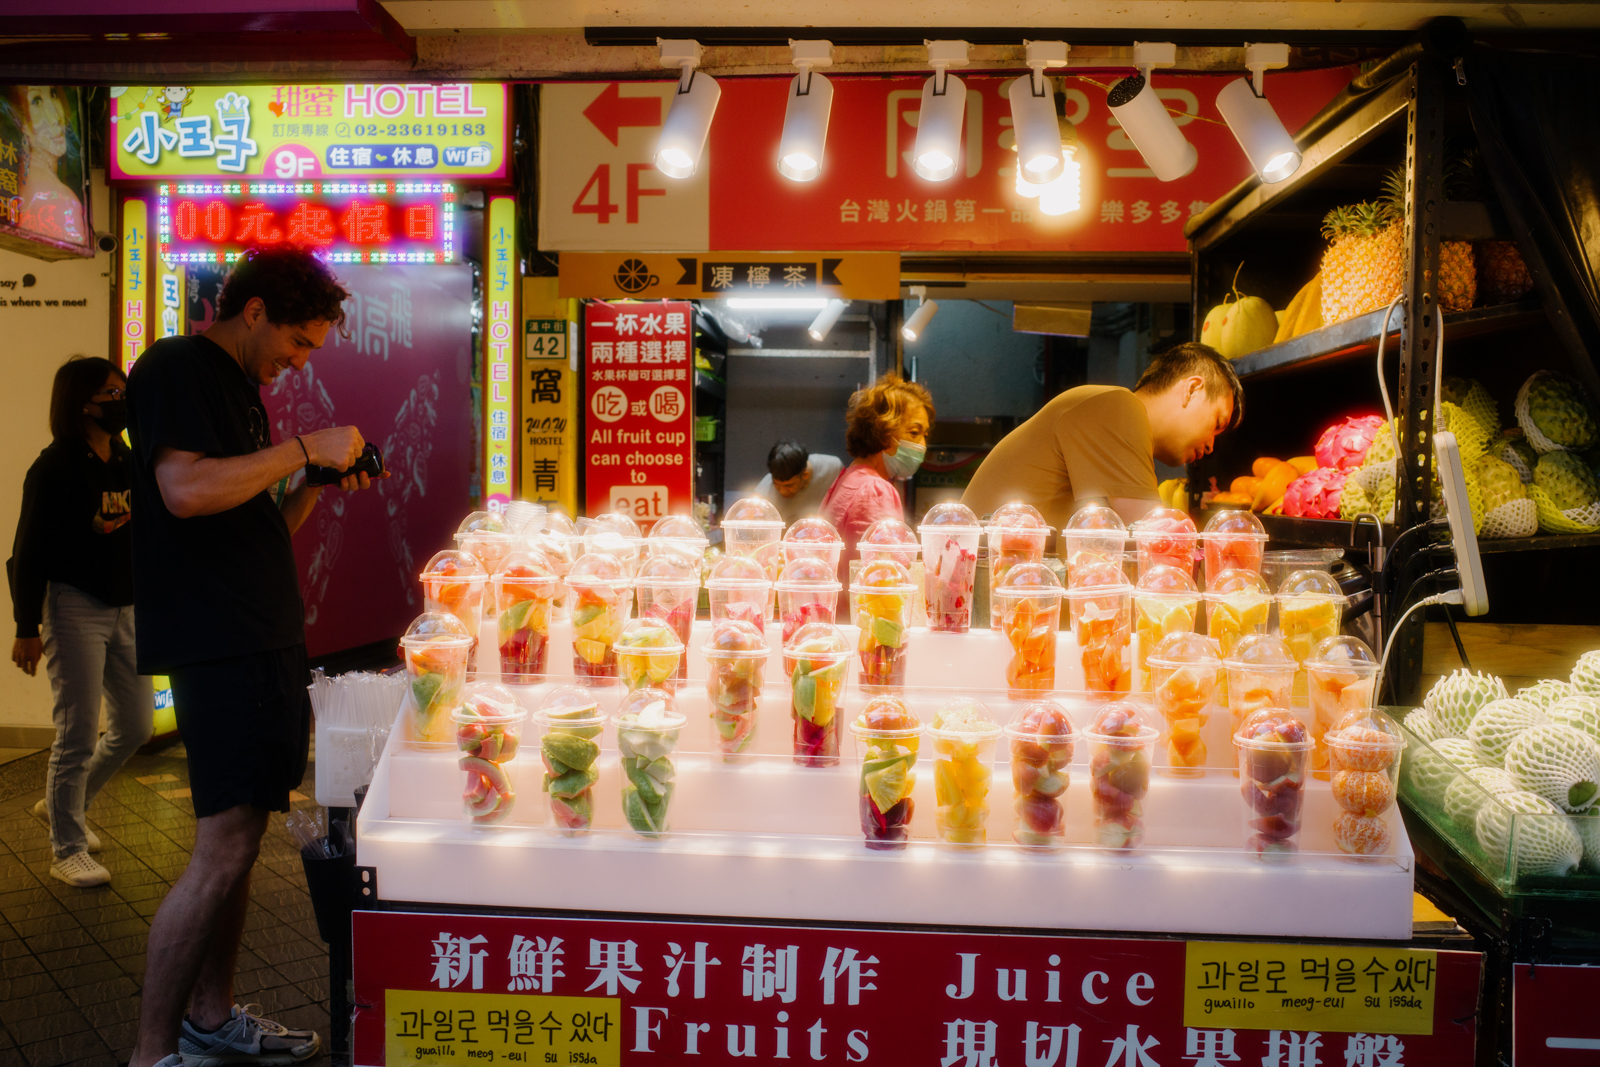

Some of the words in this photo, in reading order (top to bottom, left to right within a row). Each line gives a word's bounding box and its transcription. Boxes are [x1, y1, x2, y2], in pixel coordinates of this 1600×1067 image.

[271, 86, 338, 117] 甜蜜
[344, 84, 487, 118] HOTEL
[122, 100, 258, 172] 小王子
[272, 123, 329, 138] 訂房專線
[354, 123, 486, 137] 02-23619183
[274, 150, 315, 179] 9F
[329, 147, 372, 166] 住宿
[391, 147, 434, 166] 休息
[445, 149, 485, 163] WiFi
[572, 163, 666, 224] 4F
[125, 227, 145, 291] 小王子
[492, 227, 511, 291] 小王子
[711, 266, 808, 289] 凍檸茶
[10, 296, 41, 307] where
[44, 299, 59, 307] we
[62, 298, 87, 307] meet
[529, 321, 563, 332] 漢中街
[591, 312, 686, 336] 一杯水果
[491, 301, 510, 403] HOTEL
[533, 336, 559, 355] 42
[591, 341, 686, 364] 兩種選擇
[531, 367, 562, 404] 窩
[592, 369, 686, 382] 水果杯皆可選擇要
[596, 391, 622, 417] 吃
[631, 400, 647, 416] 或
[654, 391, 679, 416] 喝
[491, 410, 508, 440] 住宿
[591, 429, 612, 444] All
[617, 429, 651, 444] fruit
[656, 431, 685, 447] cup
[530, 437, 564, 446] HOSTEL
[490, 452, 508, 485] 休息
[591, 453, 620, 466] can
[625, 451, 683, 466] choose
[630, 469, 647, 483] to
[102, 489, 131, 514] NIK
[615, 491, 662, 517] eat
[429, 931, 880, 1006] 新鮮果汁制作
[945, 952, 1156, 1006] Juice
[1197, 959, 1288, 994] 과일로
[396, 1008, 479, 1044] 과일로
[629, 1005, 869, 1063] Fruits
